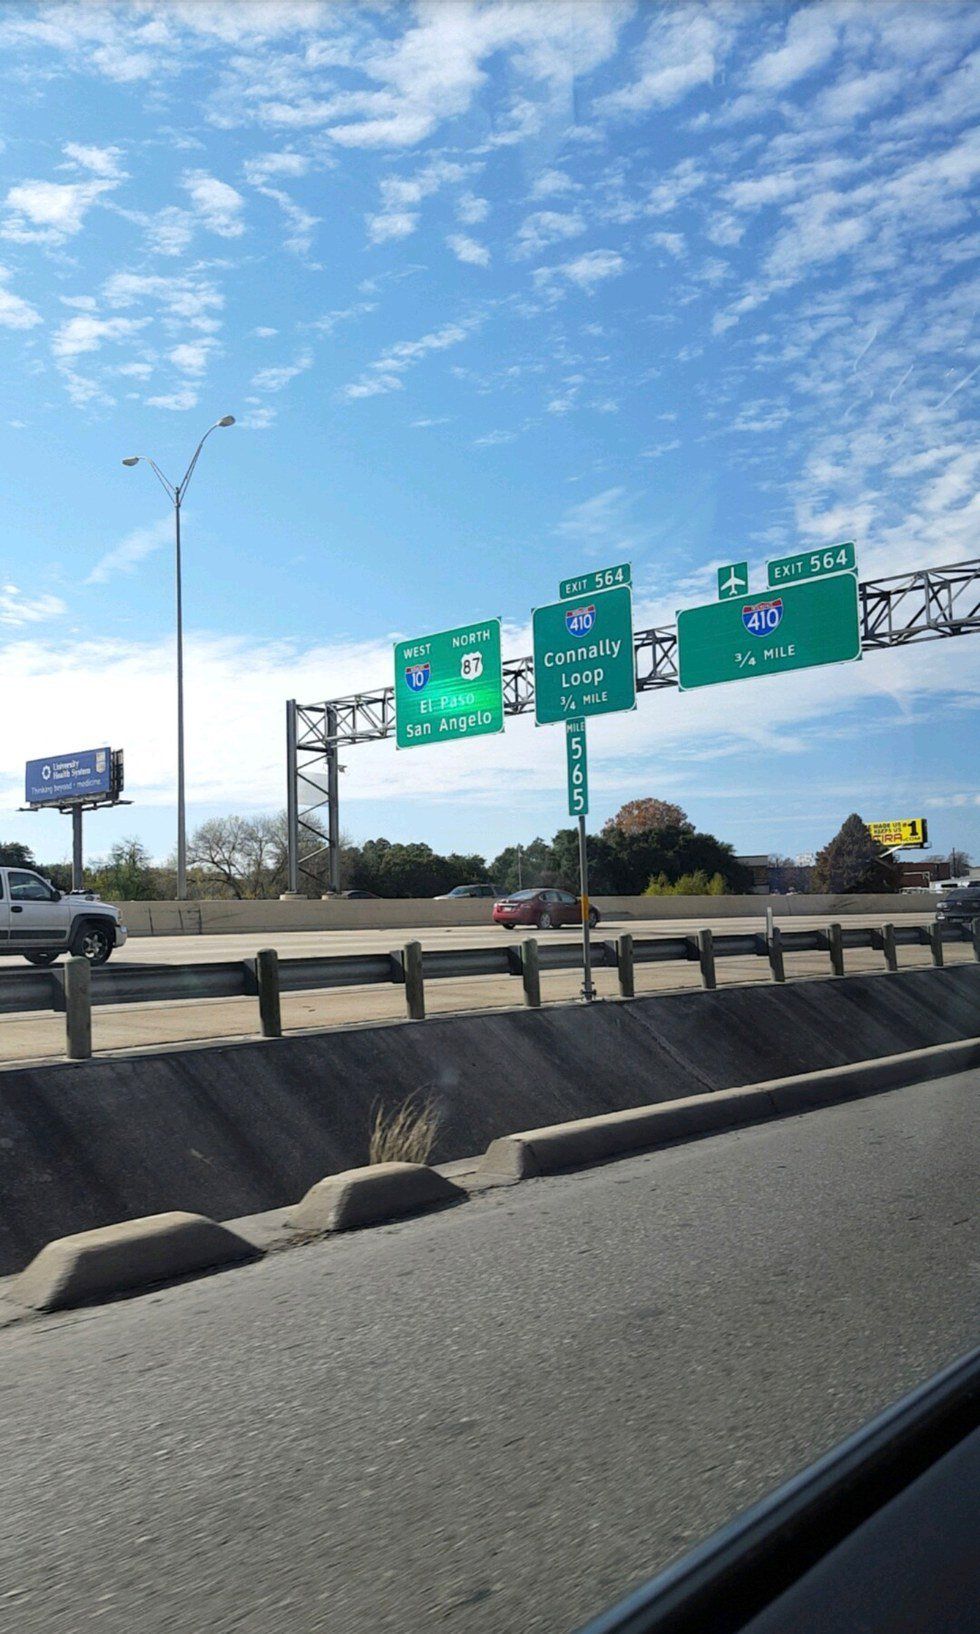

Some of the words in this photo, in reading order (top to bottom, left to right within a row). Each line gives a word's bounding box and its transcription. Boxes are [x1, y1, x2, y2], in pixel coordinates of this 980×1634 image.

[774, 561, 802, 579] EXIT
[810, 549, 848, 572] 564
[565, 580, 588, 594] EXIT
[595, 568, 624, 588] 564
[569, 613, 593, 631] 410
[747, 608, 779, 631] 410
[452, 629, 490, 648] NORTH
[403, 643, 431, 659] WEST
[543, 638, 622, 667] Connally
[764, 644, 796, 661] MILE
[463, 657, 481, 675] 87
[411, 671, 424, 688] 10
[561, 668, 604, 688] Loop
[420, 699, 432, 714] El
[441, 693, 475, 710] Paso
[583, 691, 608, 704] MILE
[406, 721, 431, 737] San
[438, 711, 492, 732] Angelo
[566, 721, 585, 734] MILE
